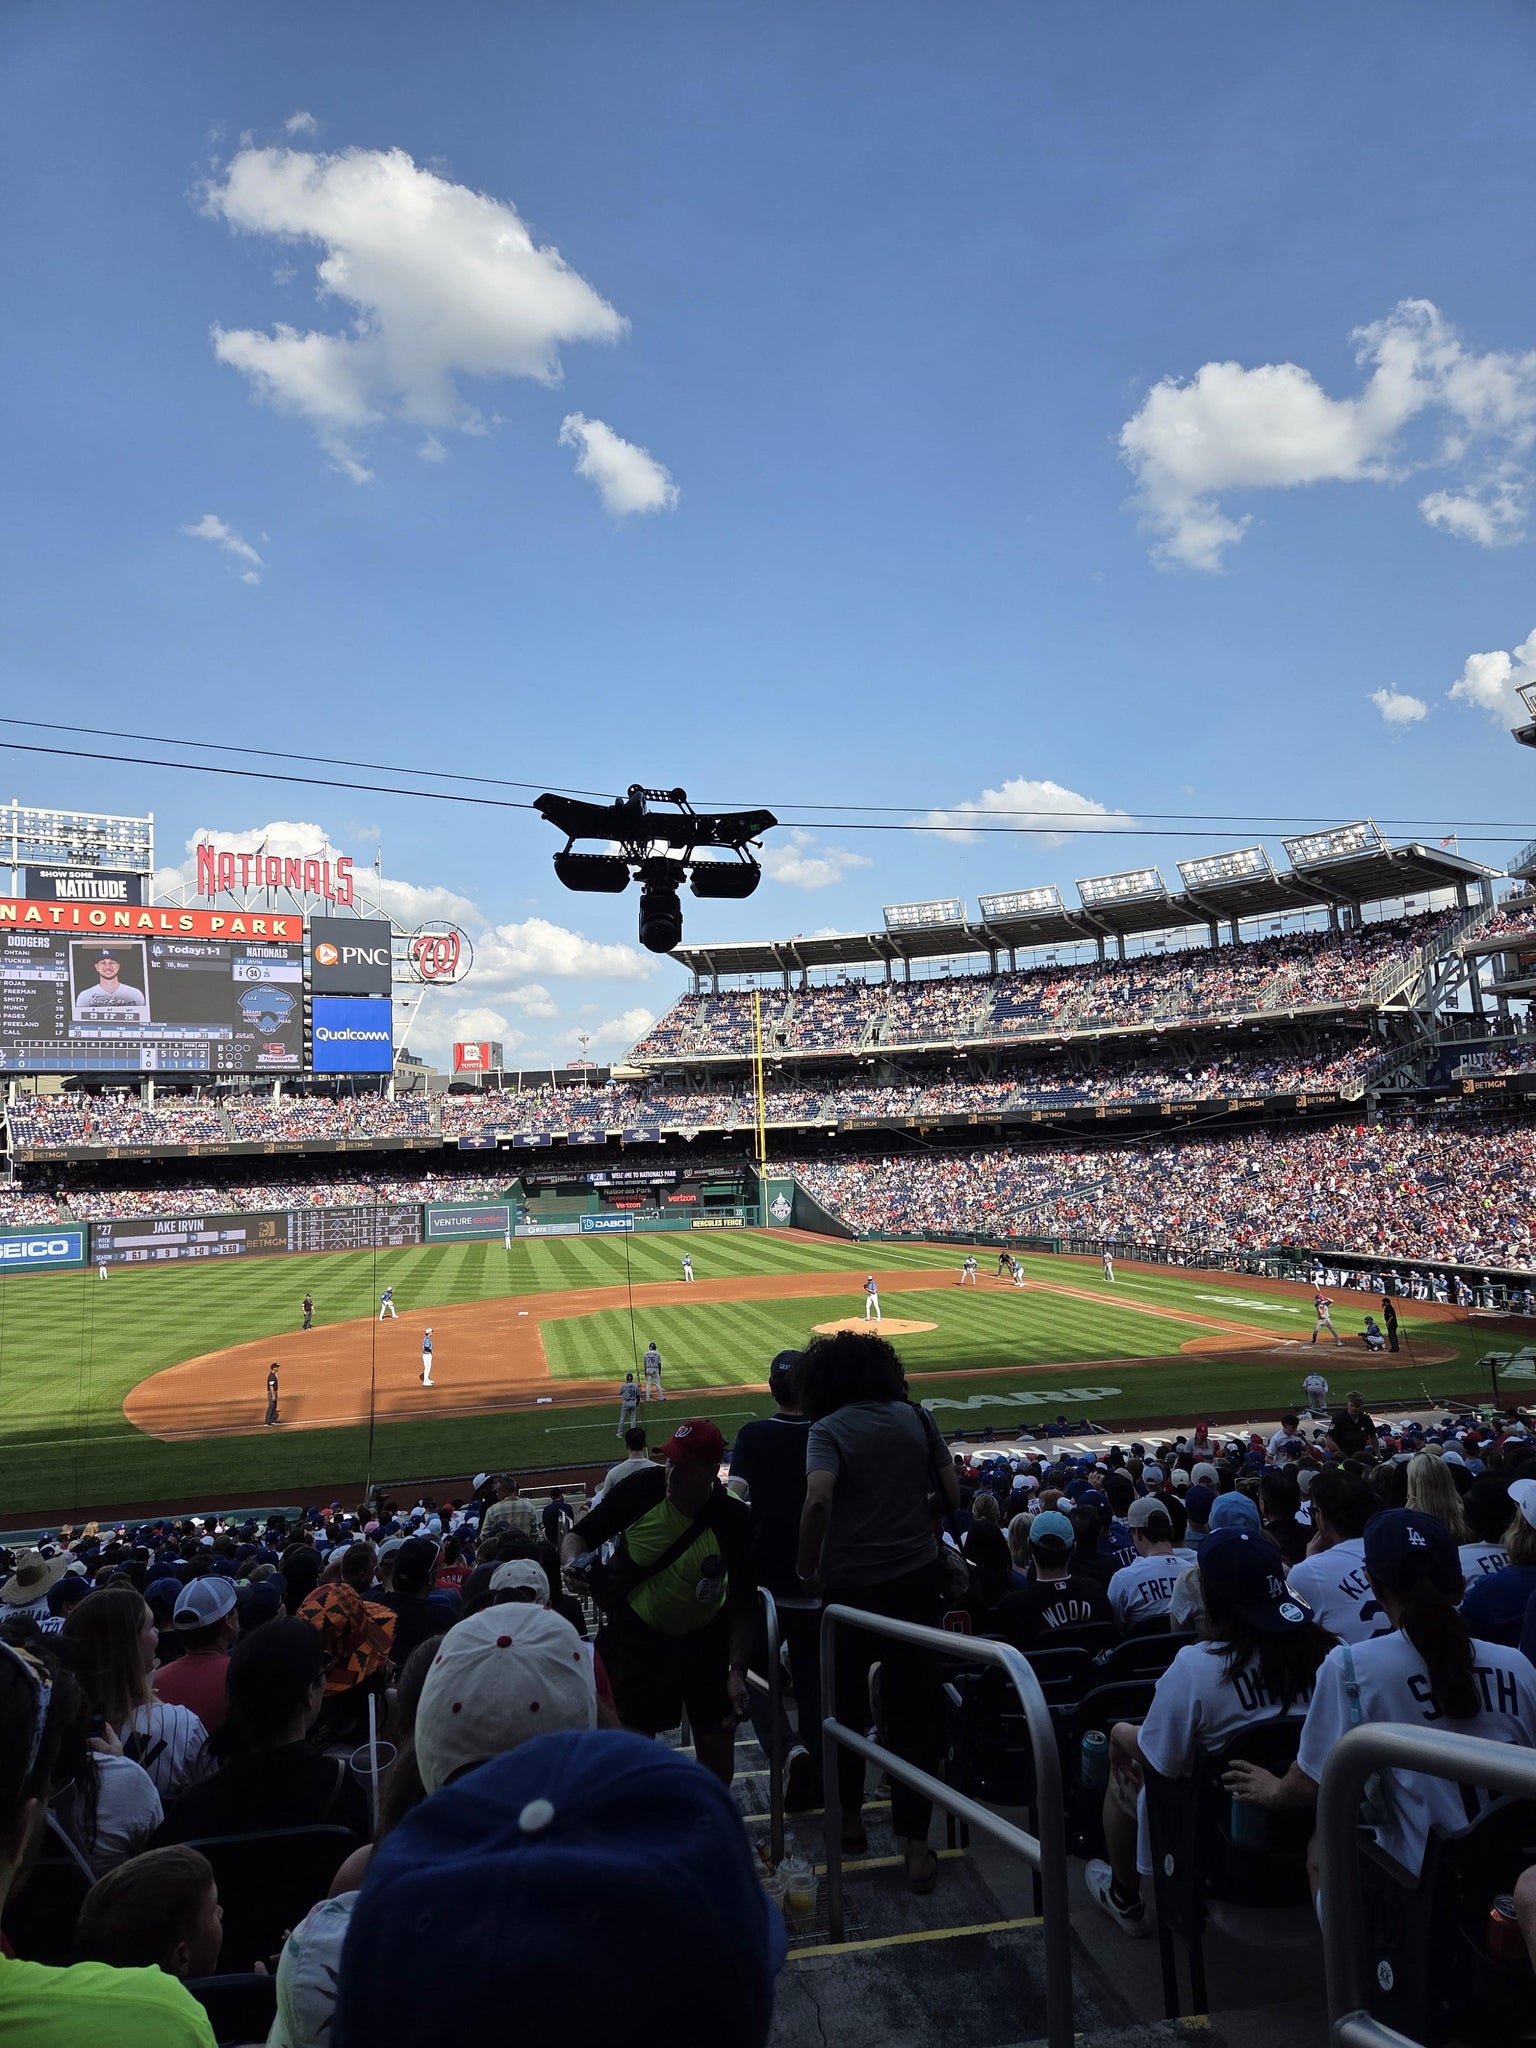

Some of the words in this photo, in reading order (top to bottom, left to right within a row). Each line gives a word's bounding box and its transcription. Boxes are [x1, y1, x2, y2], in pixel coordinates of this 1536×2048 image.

[197, 844, 353, 906] NATIONALS
[55, 879, 127, 898] NATITUDE
[0, 904, 193, 930] NATIONALS
[211, 917, 287, 936] PARK
[8, 935, 50, 948] DODGERS
[167, 945, 205, 956] Today:
[207, 947, 220, 955] 1-1
[246, 947, 288, 958] NATIONALS
[341, 946, 390, 966] PNC
[414, 931, 460, 978] W
[316, 1027, 390, 1042] Qualcomm
[19, 1049, 25, 1057] 2
[186, 1051, 193, 1059] 4
[200, 1051, 206, 1059] 2
[18, 1060, 25, 1068] 0
[145, 1060, 152, 1068] 0
[162, 1061, 166, 1069] 1
[174, 1061, 178, 1069] 1
[186, 1061, 193, 1069] 4
[200, 1061, 206, 1069] 2
[1475, 1080, 1506, 1089] BETMGM
[1239, 1100, 1264, 1108] BETMGM
[1307, 1095, 1335, 1103] BETMGM
[1171, 1104, 1196, 1112] BETMGM
[1042, 1111, 1066, 1119] BETMGM
[853, 1120, 877, 1128] BETMGM
[413, 1139, 438, 1147] BETMGM
[35, 1151, 67, 1159] BETMGM
[668, 1194, 697, 1203] verizon
[434, 1217, 472, 1227] VENTURE
[473, 1216, 505, 1224] GLOBAL
[595, 1219, 631, 1227] DABOS
[692, 1219, 722, 1228] HERCULES
[96, 1225, 112, 1236] #27
[153, 1221, 176, 1234] JAKE
[178, 1219, 204, 1232] IRVIN
[246, 1238, 287, 1248] BETMGM
[0, 1240, 69, 1258] EICO
[132, 1251, 141, 1259] 6.1
[194, 1247, 204, 1255] 1-0
[222, 1243, 237, 1252] 5.68
[920, 1387, 1123, 1411] AARP
[1406, 1526, 1426, 1547] LA
[1266, 1574, 1284, 1599] LA
[1042, 1600, 1092, 1629] WOOD
[1407, 1667, 1519, 1721] STH
